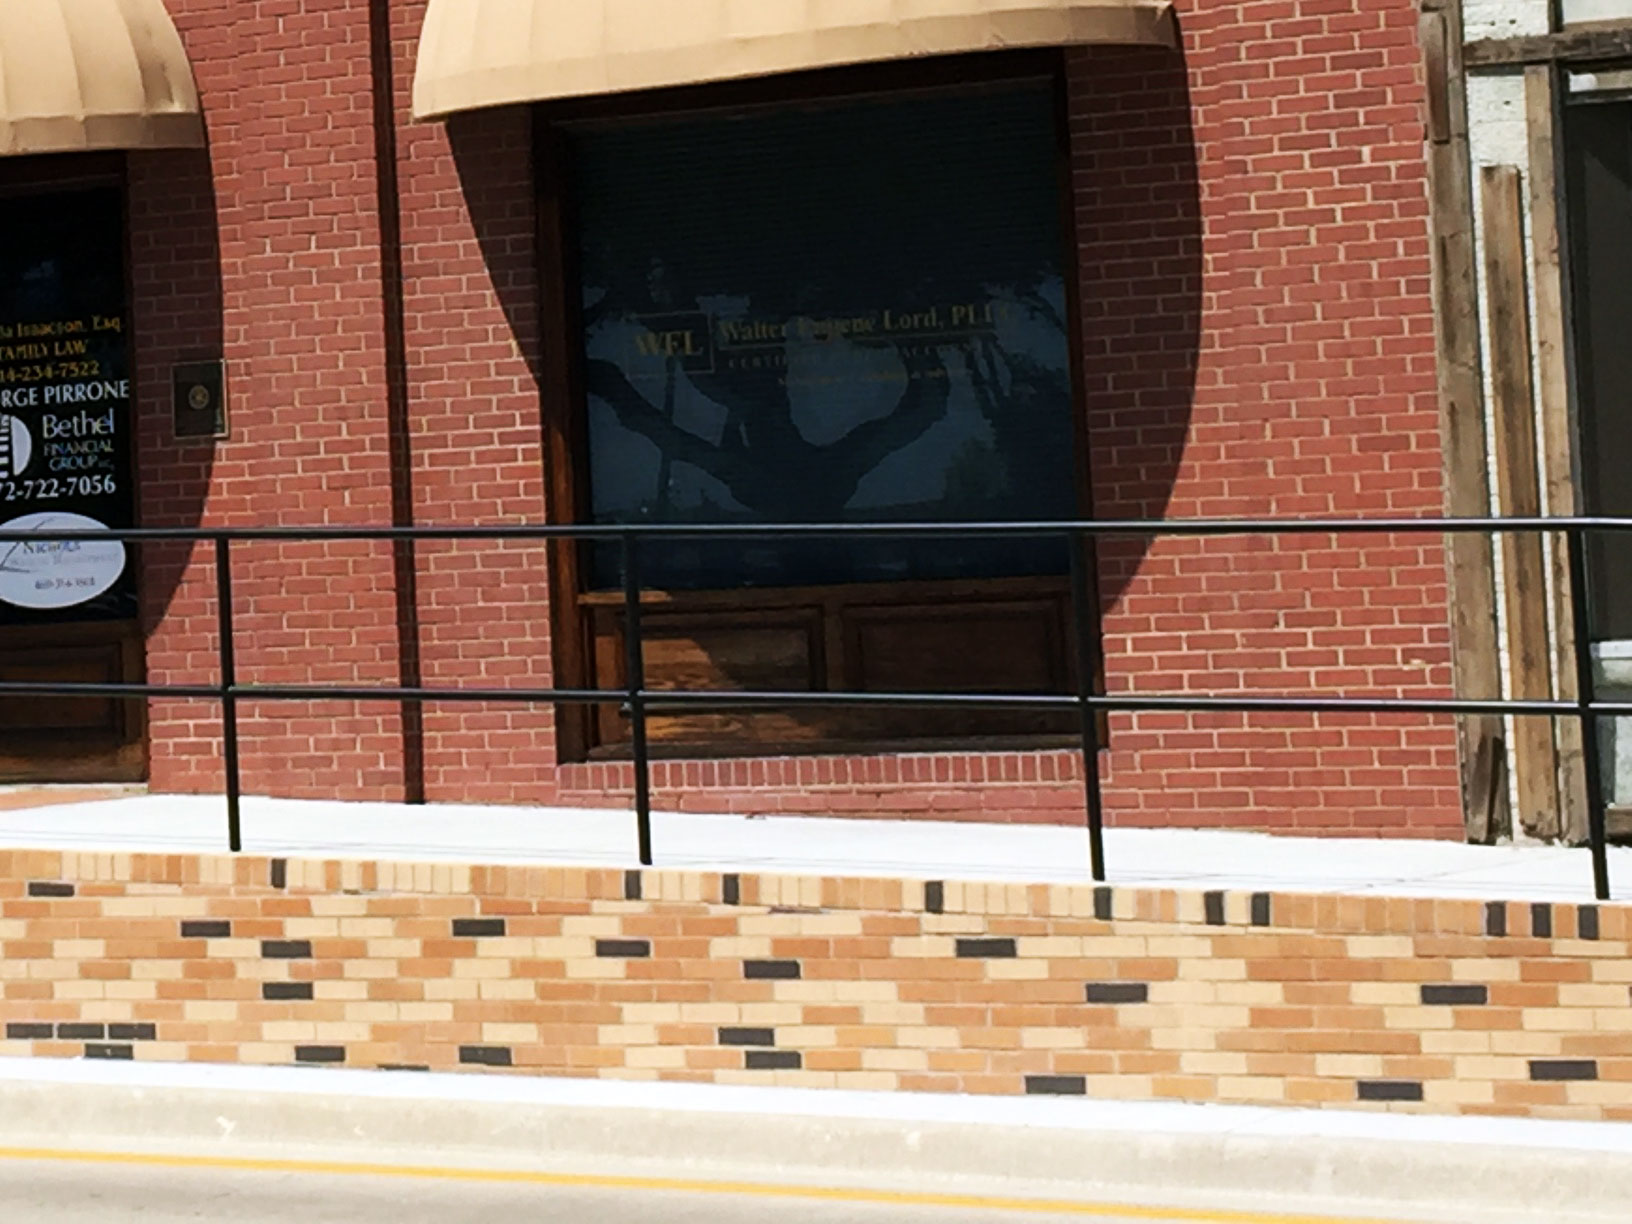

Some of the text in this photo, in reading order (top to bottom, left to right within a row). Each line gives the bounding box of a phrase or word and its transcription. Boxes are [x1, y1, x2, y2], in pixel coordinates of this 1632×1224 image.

[53, 339, 88, 357] LAW
[43, 380, 130, 404] PIRRONE
[42, 407, 115, 439] Bethel
[44, 440, 115, 457] FINANCIAL
[49, 455, 98, 472] GROUP
